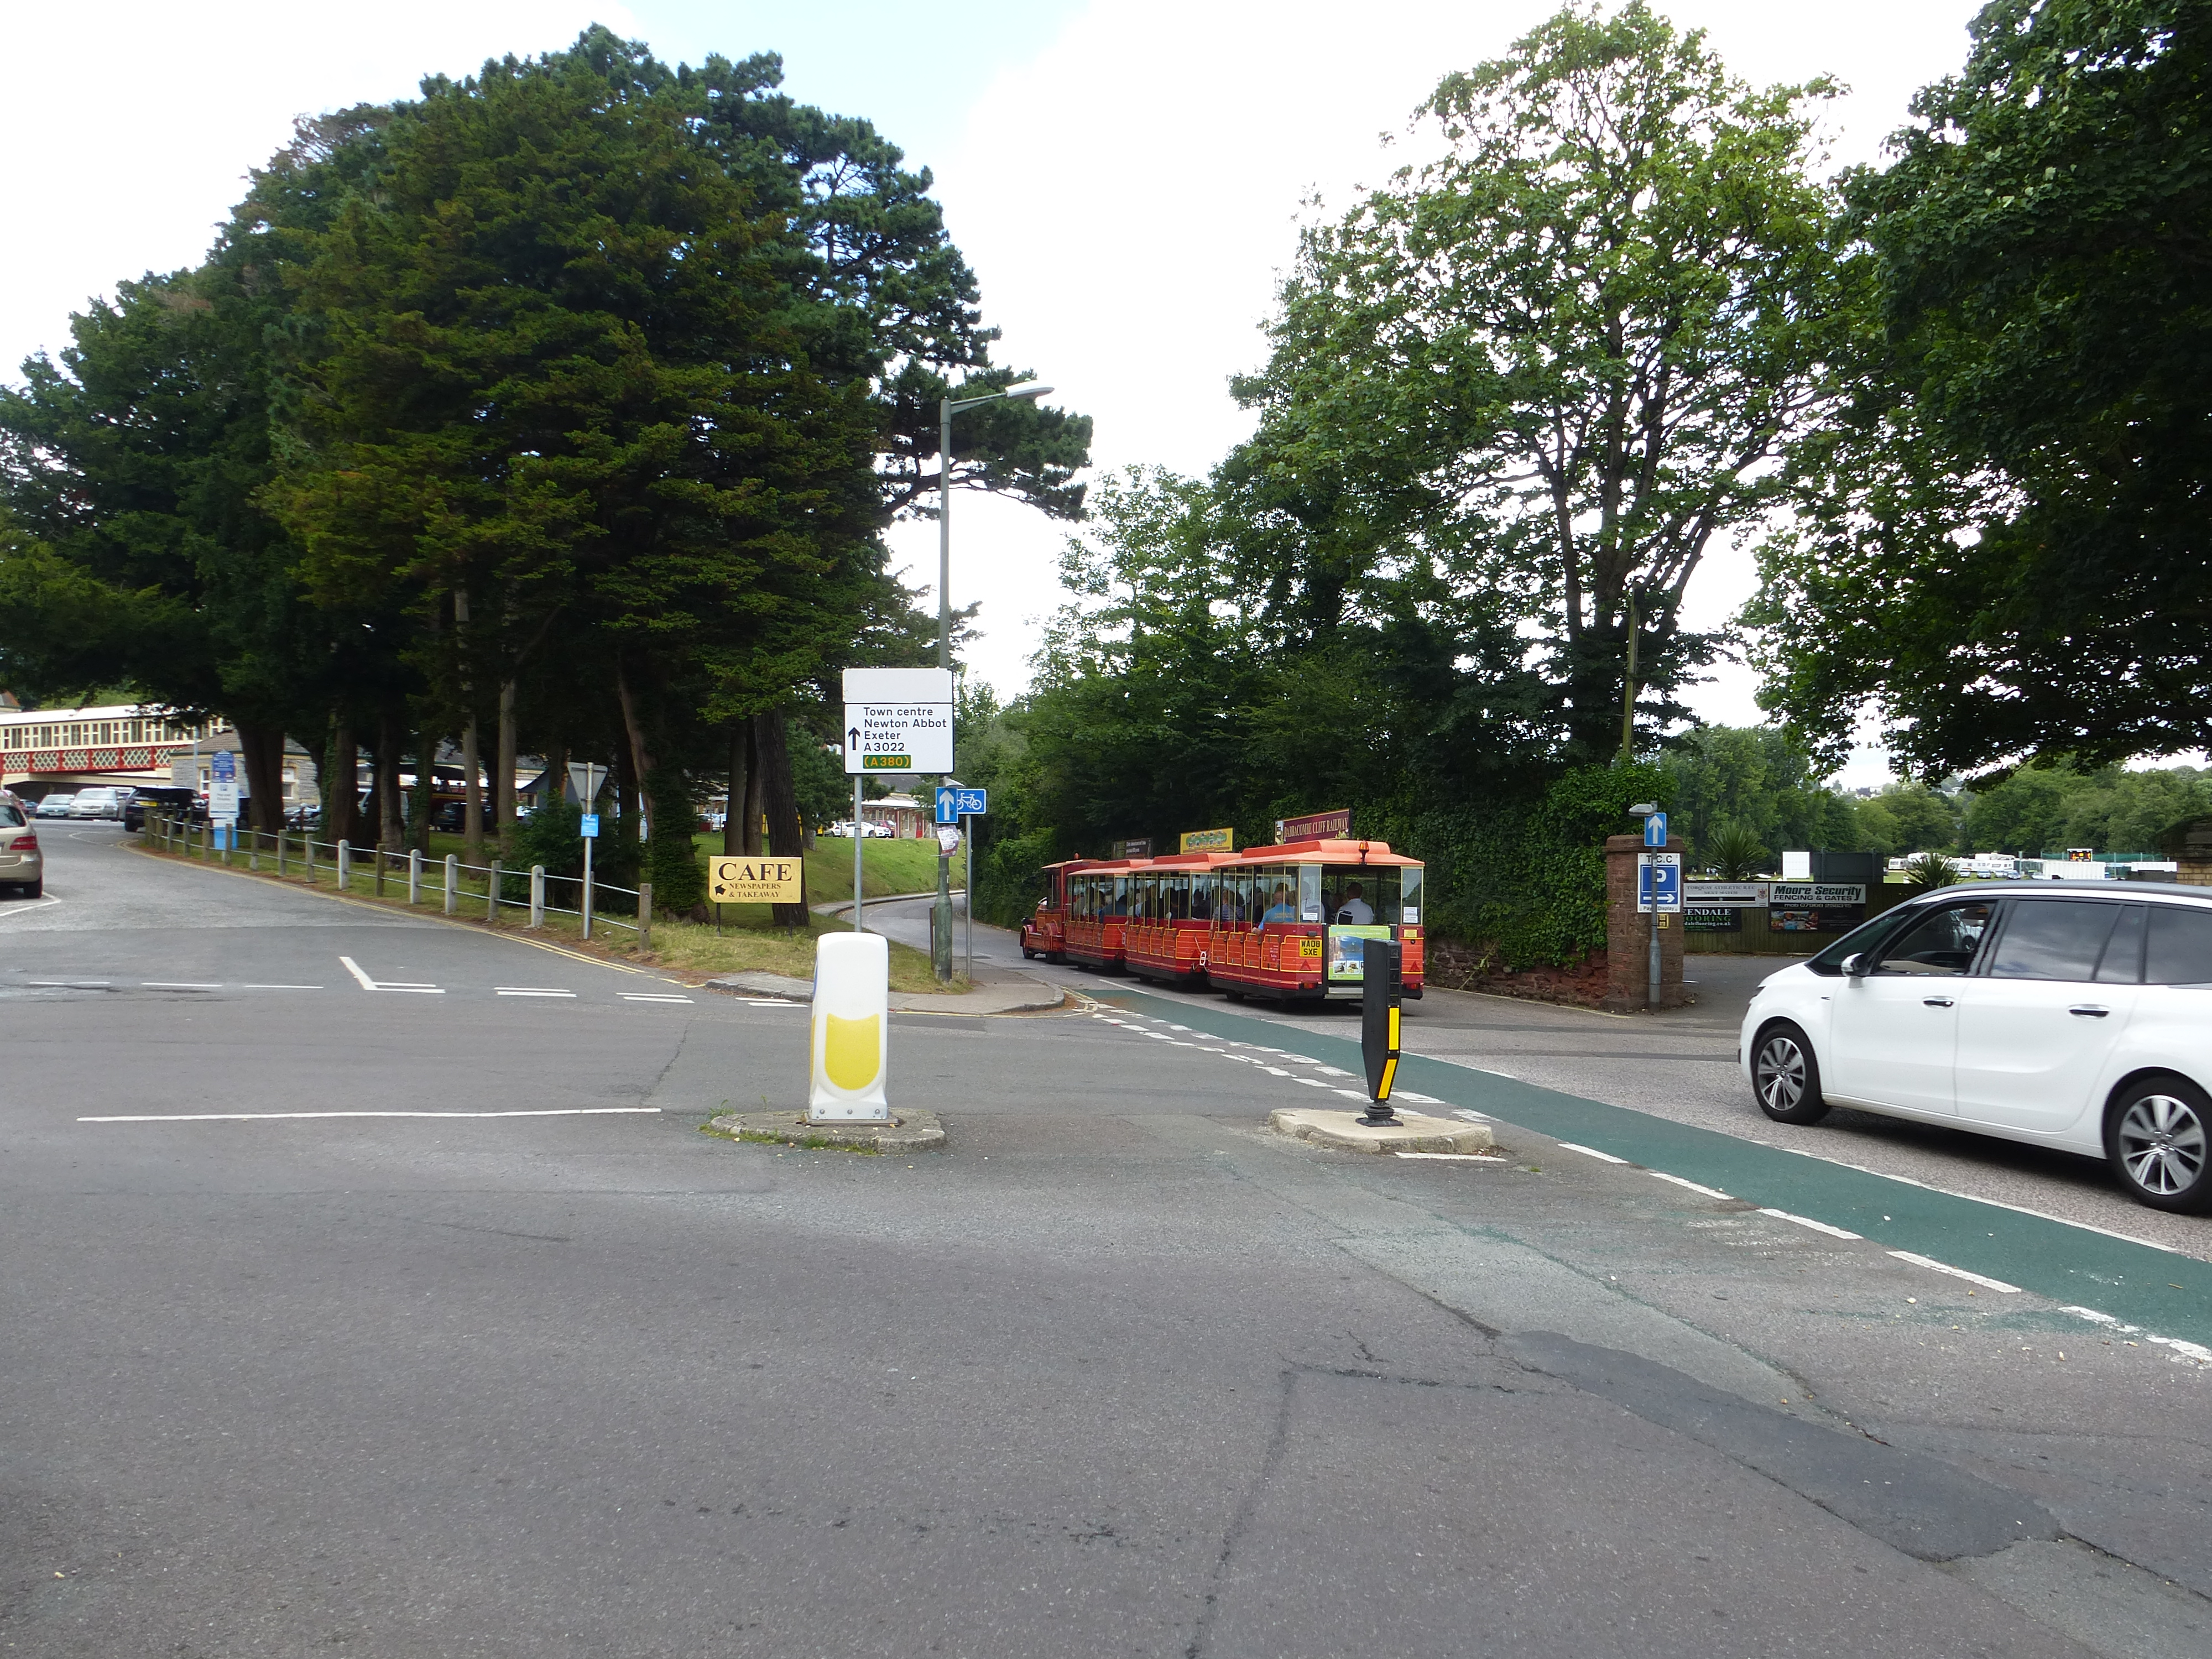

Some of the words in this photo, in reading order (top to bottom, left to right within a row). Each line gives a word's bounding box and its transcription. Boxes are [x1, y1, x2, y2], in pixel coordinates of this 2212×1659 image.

[863, 707, 893, 716] Town
[897, 707, 933, 716] centre
[864, 719, 908, 728] Newton
[912, 719, 947, 728] Abbot
[864, 731, 901, 739] Exeter
[864, 743, 905, 752] A3022
[864, 757, 910, 768] (A380)
[1284, 823, 1312, 837] BABBACOMBE
[1312, 820, 1326, 834] CLIFF
[1327, 817, 1348, 832] RAILWAY
[718, 863, 792, 881] CAFE
[1775, 886, 1812, 895] Moore
[1814, 886, 1861, 901] Security
